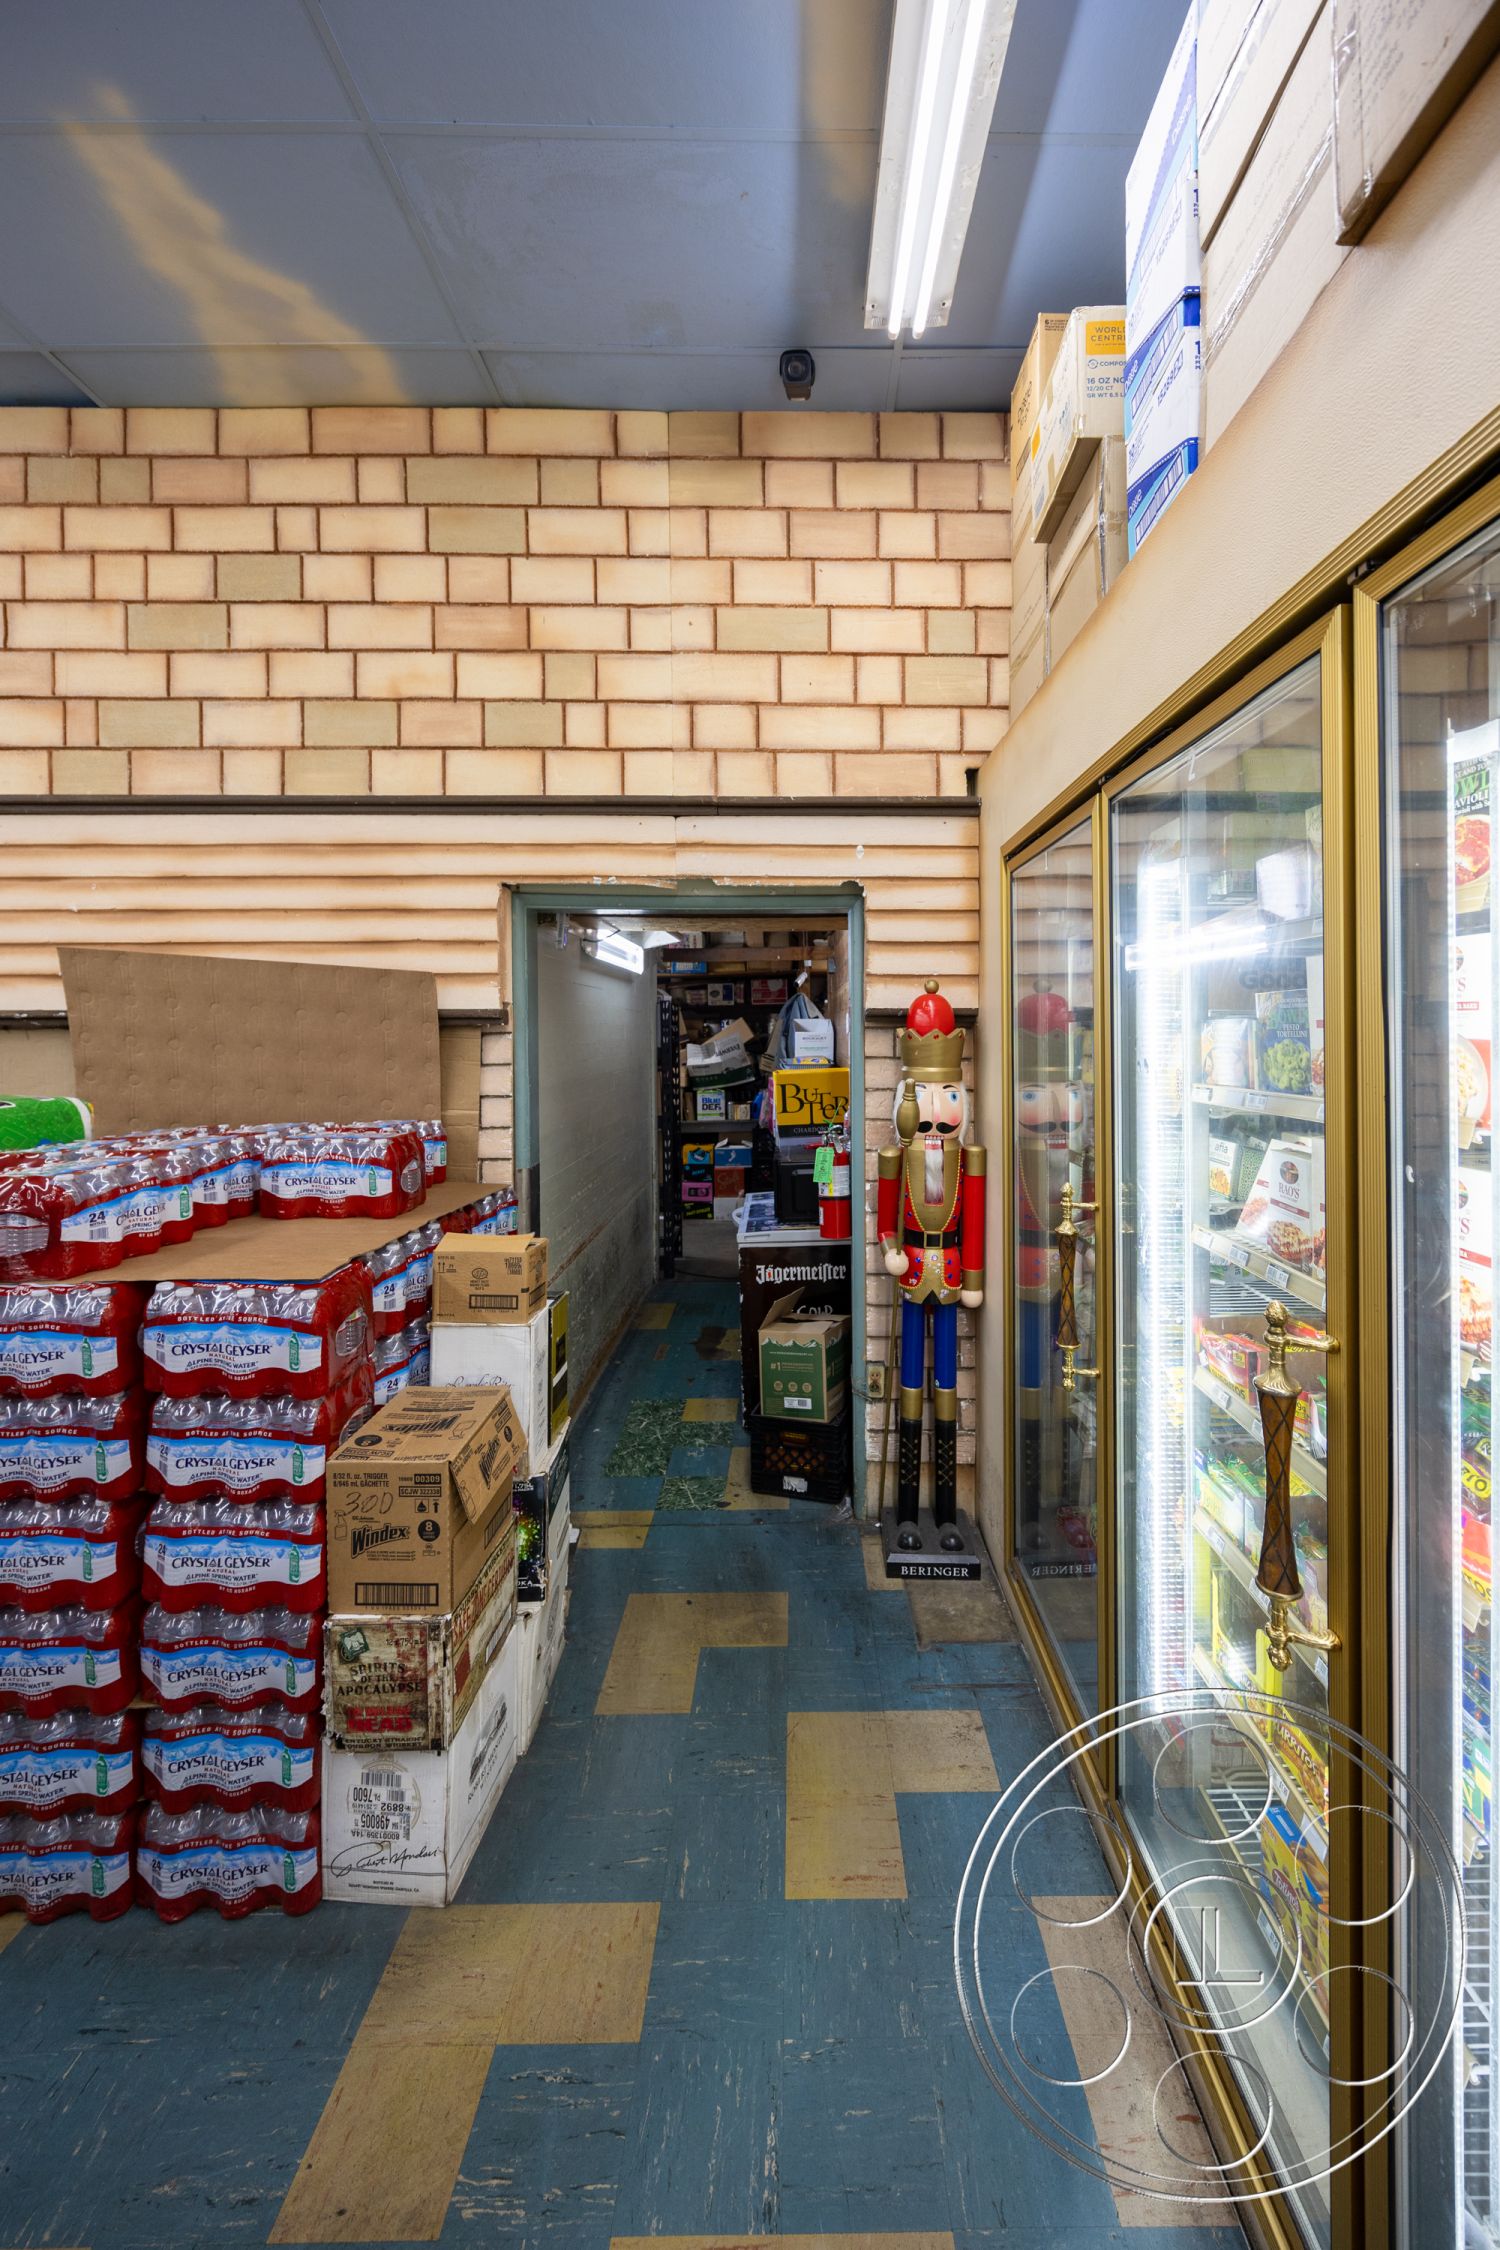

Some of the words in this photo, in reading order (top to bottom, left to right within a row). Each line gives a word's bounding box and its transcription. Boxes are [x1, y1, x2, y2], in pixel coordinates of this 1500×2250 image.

[1455, 791, 1488, 808] AVIOLI
[203, 1179, 215, 1187] 24
[285, 1177, 319, 1187] CRYSTAL
[323, 1177, 357, 1186] GEYSER
[89, 1211, 106, 1223] 24
[756, 1263, 846, 1284] Jägermeister
[384, 1284, 395, 1294] 24
[157, 1332, 165, 1344] 24
[171, 1344, 224, 1356] CRYSTAL
[225, 1344, 270, 1356] GEYSER
[17, 1351, 64, 1364] GEYSER
[186, 1357, 213, 1367] ALPINE
[232, 1361, 256, 1369] WATER
[387, 1378, 398, 1388] 24
[160, 1445, 168, 1456] 24
[33, 1455, 81, 1469] GEYSER
[176, 1458, 228, 1469] CRYSTAL
[229, 1458, 275, 1470] GEYSER
[190, 1471, 217, 1481] ALPINE
[236, 1474, 260, 1483] WATER
[425, 1522, 432, 1530] 8
[352, 1523, 410, 1559] Windex
[158, 1543, 166, 1554] 24
[20, 1556, 65, 1568] GEYSER
[172, 1557, 223, 1569] CRYSTAL
[224, 1557, 270, 1568] GEYSER
[901, 1566, 969, 1577] BERINGER
[174, 1640, 209, 1649] BOTTLED
[153, 1656, 161, 1668] 24
[20, 1666, 65, 1677] GEYSER
[168, 1667, 220, 1683] CRYSTAL
[221, 1667, 267, 1682] GEYSER
[350, 1663, 406, 1676] SPIRITS
[183, 1682, 209, 1692] ALPINE
[337, 1682, 422, 1696] APOCALYPSE
[176, 1727, 212, 1738] BOTTLED
[43, 1742, 75, 1751] SOURCE
[168, 1756, 220, 1773] CRYSTAL
[221, 1757, 264, 1772] GEYSER
[31, 1769, 79, 1786] GEYSER
[183, 1774, 208, 1783] ALPINE
[353, 1788, 372, 1802] 7600
[381, 1803, 404, 1811] 8892
[361, 1814, 390, 1829] 498005
[152, 1859, 161, 1870] 24
[27, 1872, 74, 1887] GEYSER
[170, 1868, 222, 1882] CRYSTAL
[222, 1865, 268, 1881] GEYSER
